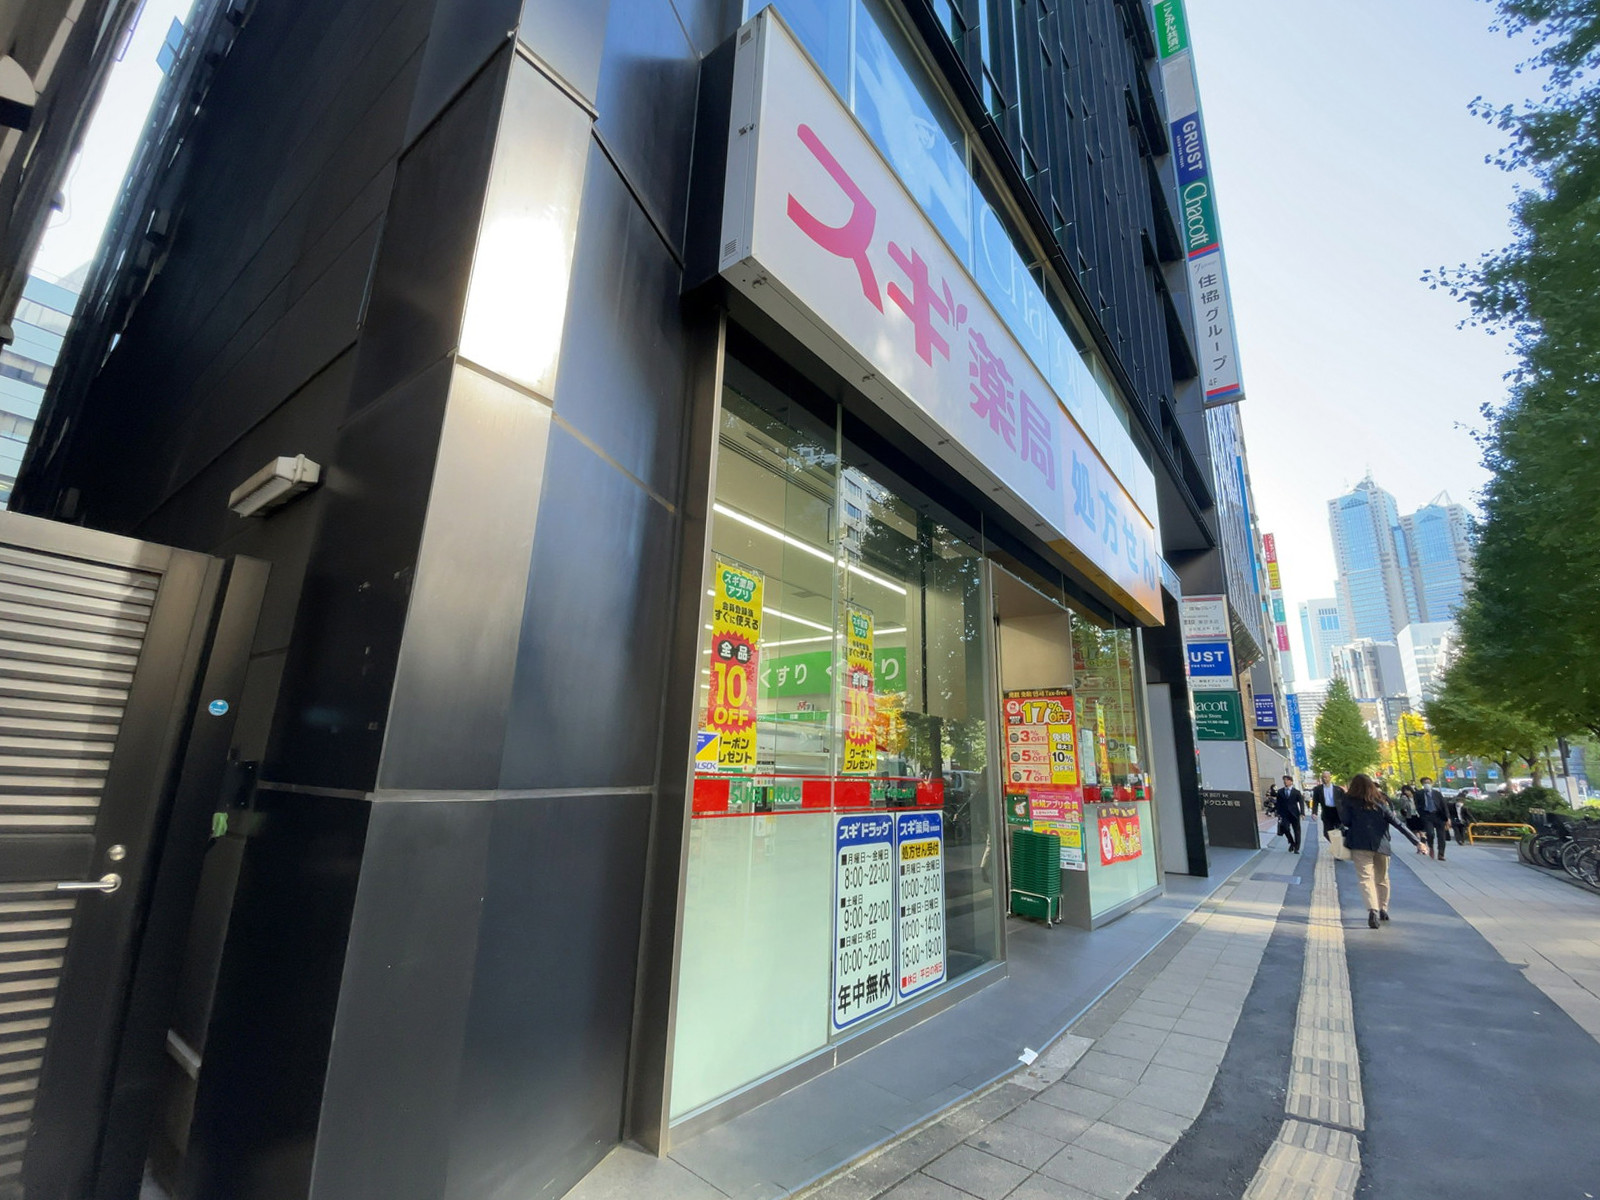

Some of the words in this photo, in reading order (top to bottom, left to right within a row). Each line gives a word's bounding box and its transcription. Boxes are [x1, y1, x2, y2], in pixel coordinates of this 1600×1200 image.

[1182, 120, 1203, 171] GRUST
[1183, 182, 1210, 248] Chacott
[787, 122, 1056, 491] スギ薬局
[1197, 273, 1228, 371] 住協グループ
[1071, 450, 1156, 592] 処方せん
[728, 585, 750, 600] アプリ
[714, 609, 759, 631] すぐに使える
[720, 640, 748, 662] 全品
[1191, 651, 1224, 662] UST
[759, 663, 808, 690] くすり
[713, 707, 749, 726] OFF
[1049, 711, 1070, 723] OFF
[718, 751, 753, 765] レゼント
[846, 760, 875, 770] プレゼント
[1052, 751, 1074, 763] 10%
[730, 785, 763, 804] SUGI
[767, 786, 802, 803] DRUG
[1031, 799, 1079, 810] 新規アプリ会員
[900, 819, 930, 836] スギ薬局
[902, 841, 939, 861] 処方せん受付
[847, 894, 864, 908] 土曜日
[837, 968, 891, 1015] 年中無休
